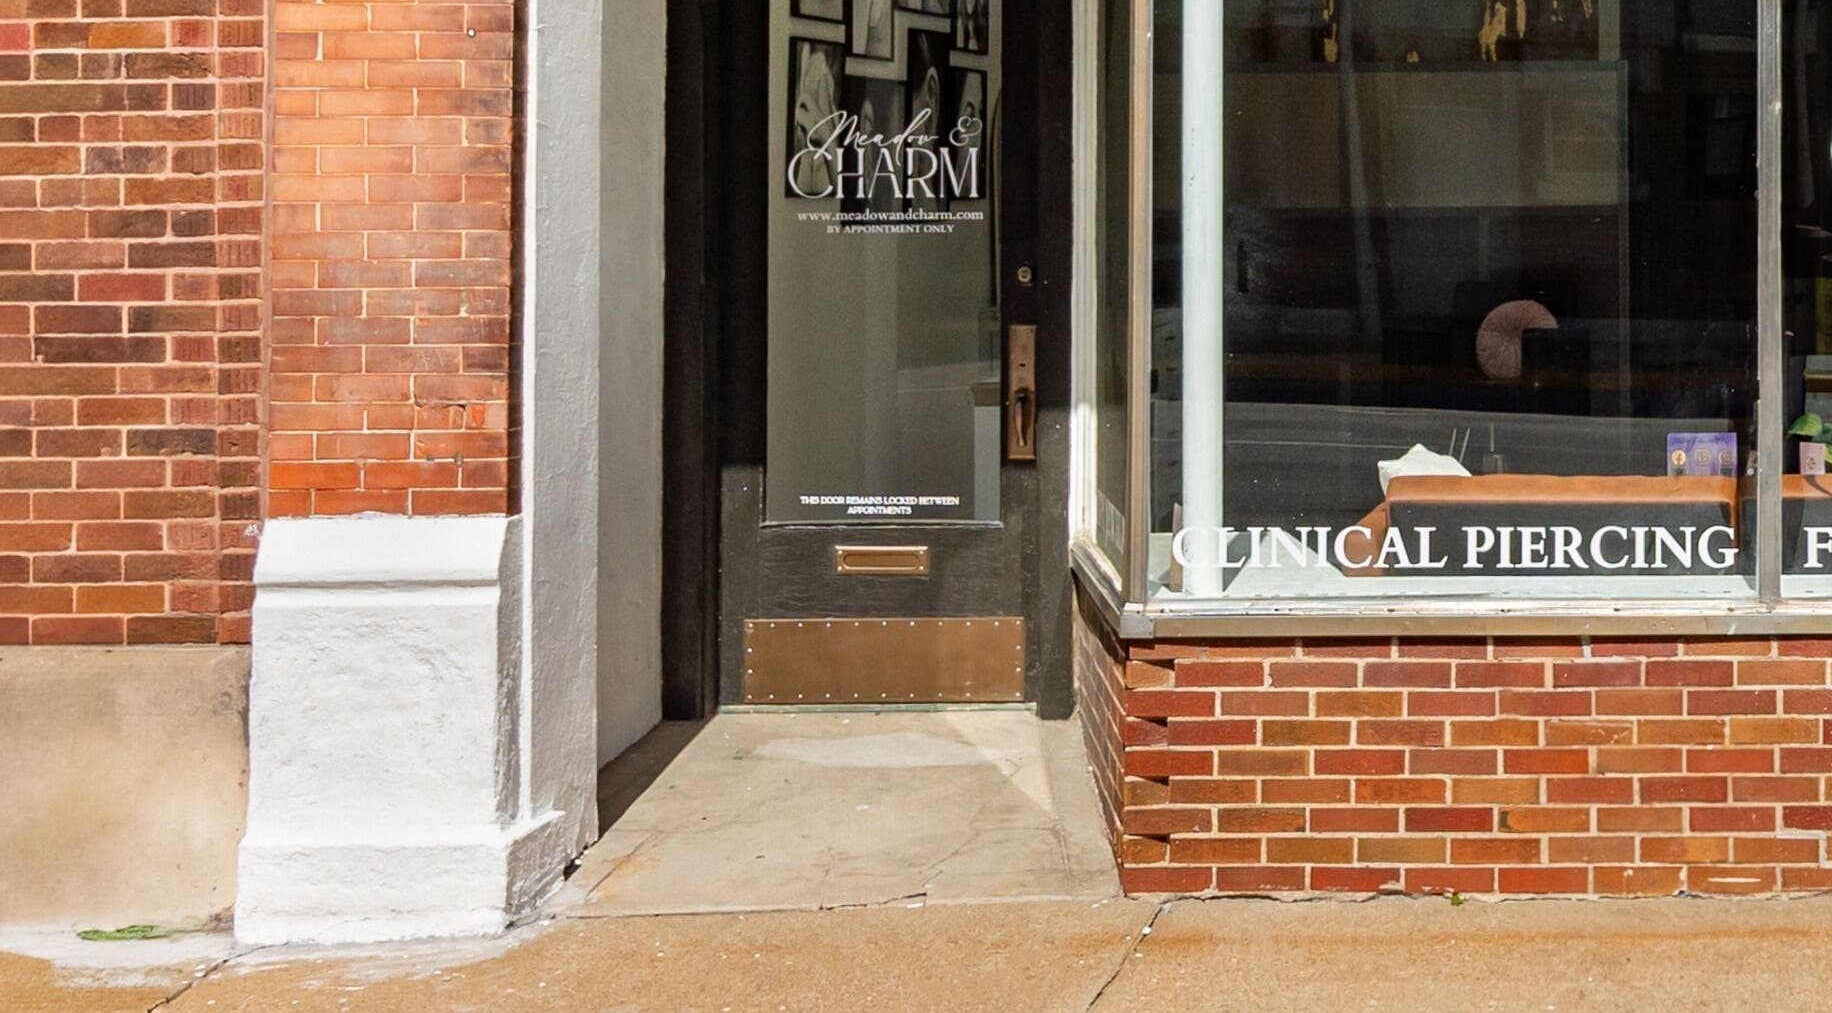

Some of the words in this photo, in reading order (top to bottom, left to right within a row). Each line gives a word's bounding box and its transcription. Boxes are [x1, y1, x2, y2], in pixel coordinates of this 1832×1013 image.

[806, 108, 940, 167] Meadow
[949, 115, 983, 146] &
[787, 147, 979, 200] CHARM
[797, 207, 984, 221] www.meadowandcharm.com
[826, 224, 841, 234] BY
[844, 224, 922, 234] APPOINTMENT
[923, 224, 955, 234] ONLY
[800, 495, 820, 505] THIS
[820, 495, 845, 505] DOOR
[846, 495, 883, 505] REMAINS
[884, 495, 917, 505] LOCKED
[918, 495, 960, 505] BETWEEN
[846, 506, 912, 515] APPOINTMENTS
[1172, 525, 1448, 570] CLINICAL
[1461, 525, 1740, 570] PIERCING
